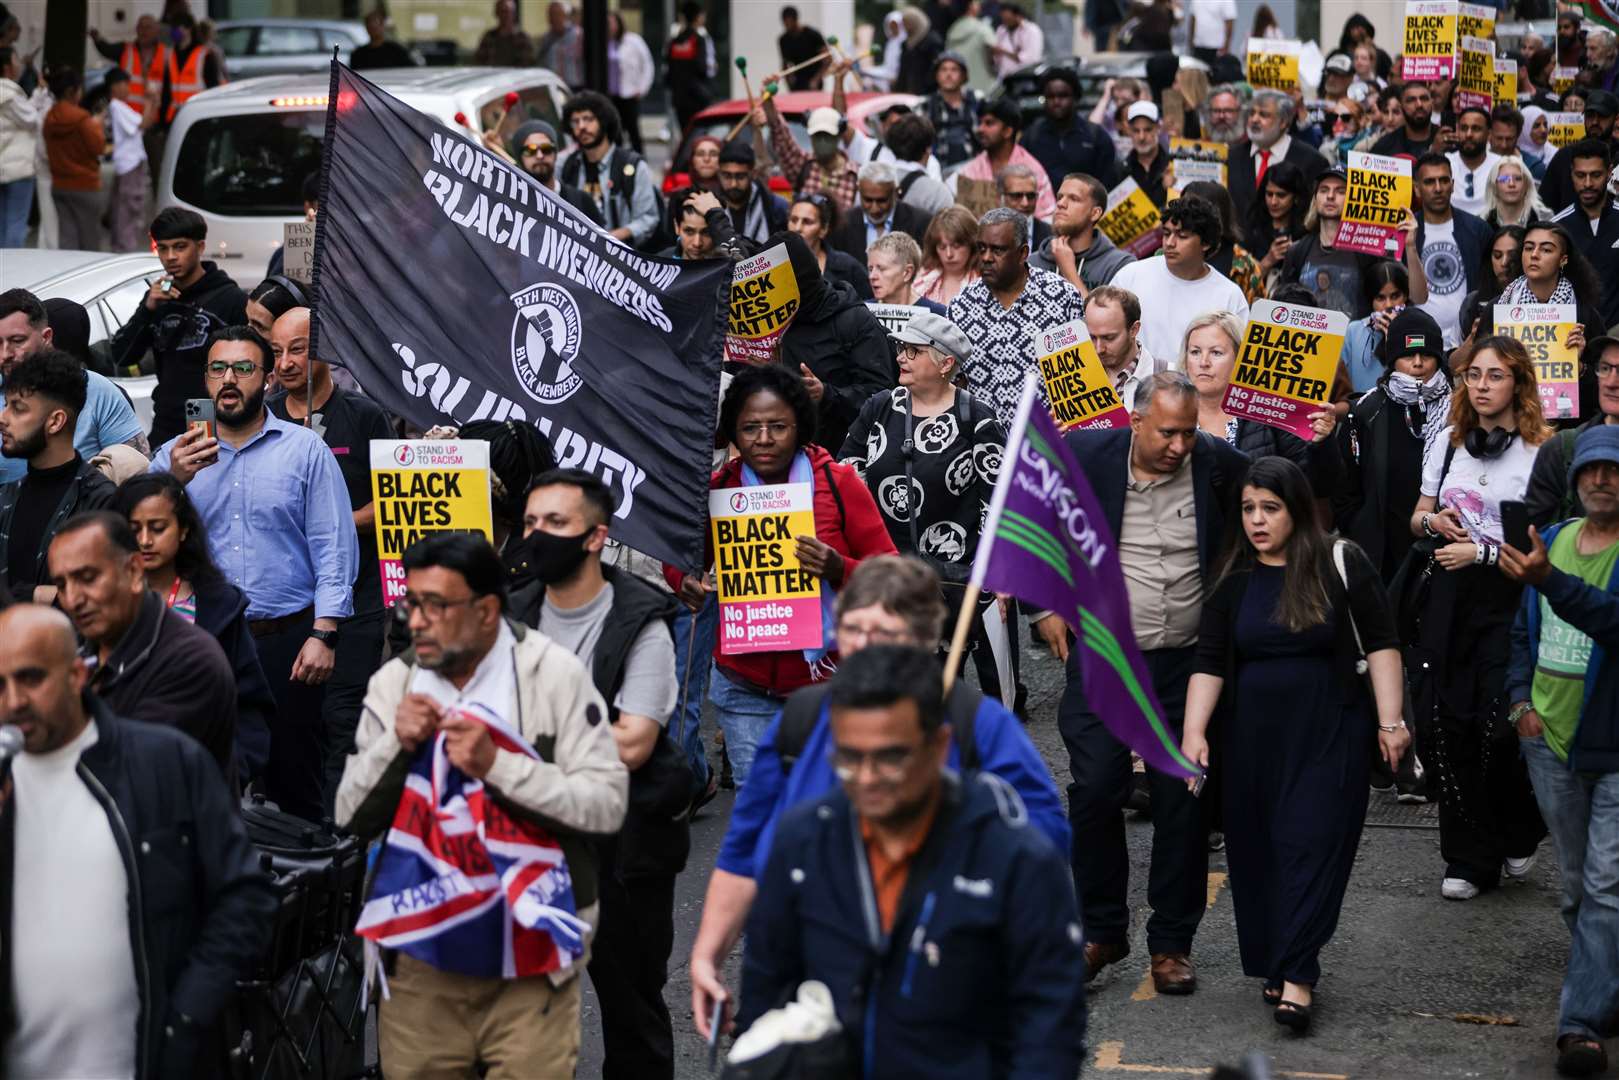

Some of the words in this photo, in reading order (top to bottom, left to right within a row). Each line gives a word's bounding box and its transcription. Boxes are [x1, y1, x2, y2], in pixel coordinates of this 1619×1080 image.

[1407, 16, 1444, 29] BLACK
[1406, 30, 1438, 42] LIVES
[1405, 42, 1452, 54] MATTER
[1462, 51, 1487, 67] BLACK
[1461, 64, 1483, 78] LIVES
[1460, 77, 1492, 92] MATTER
[430, 132, 528, 205] NORTH
[1350, 170, 1397, 191] BLACK
[1348, 186, 1389, 206] LIVES
[1345, 203, 1406, 225] MATTER
[288, 223, 312, 234] THIS
[1341, 222, 1354, 232] No
[1354, 225, 1386, 237] justice
[288, 238, 312, 248] BEEN
[1338, 232, 1351, 242] No
[1352, 235, 1380, 247] peace
[423, 169, 538, 258] BLACK
[537, 225, 673, 334] MEMBERS
[744, 261, 771, 277] RACISM
[755, 256, 765, 266] UP
[731, 273, 775, 304] ACK
[729, 296, 771, 320] VES
[1291, 309, 1315, 320] STAND
[1315, 312, 1327, 321] UP
[513, 288, 540, 308] RTH
[541, 288, 568, 309] WEST
[562, 304, 579, 354] UNISON
[1290, 317, 1300, 326] TO
[1300, 319, 1329, 330] RACISM
[743, 336, 779, 349] justic
[1052, 329, 1067, 341] STAND
[1065, 327, 1073, 335] UP
[1054, 340, 1062, 348] TO
[1060, 334, 1078, 345] RACISM
[1247, 324, 1322, 355] BLACK
[728, 343, 746, 355] No
[1041, 347, 1086, 381] BLACK
[1241, 345, 1305, 375] LIVES
[515, 344, 539, 389] BLACK
[534, 372, 581, 398] MEMBERS
[1047, 372, 1087, 403] LIVES
[1235, 364, 1327, 401] MATTER
[1053, 386, 1118, 423] MATTER
[1230, 386, 1248, 400] No
[1250, 391, 1297, 412] justice
[1226, 397, 1245, 410] No
[1246, 404, 1287, 420] peace
[416, 446, 444, 455] STAND
[445, 445, 458, 454] UP
[417, 455, 429, 464] TO
[430, 455, 464, 464] RACISM
[377, 472, 462, 498] BLACK
[750, 491, 774, 501] STAND
[775, 490, 787, 500] UP
[379, 500, 451, 526] LIVES
[751, 502, 761, 511] TO
[762, 499, 792, 510] RACISM
[716, 515, 792, 545] BLACK
[719, 543, 784, 571] LIVES
[385, 562, 406, 579] No
[387, 580, 408, 597] No
[721, 568, 815, 597] MATTER
[724, 605, 743, 622] No
[746, 602, 793, 624] justice
[725, 623, 744, 639] No
[748, 622, 789, 641] peace
